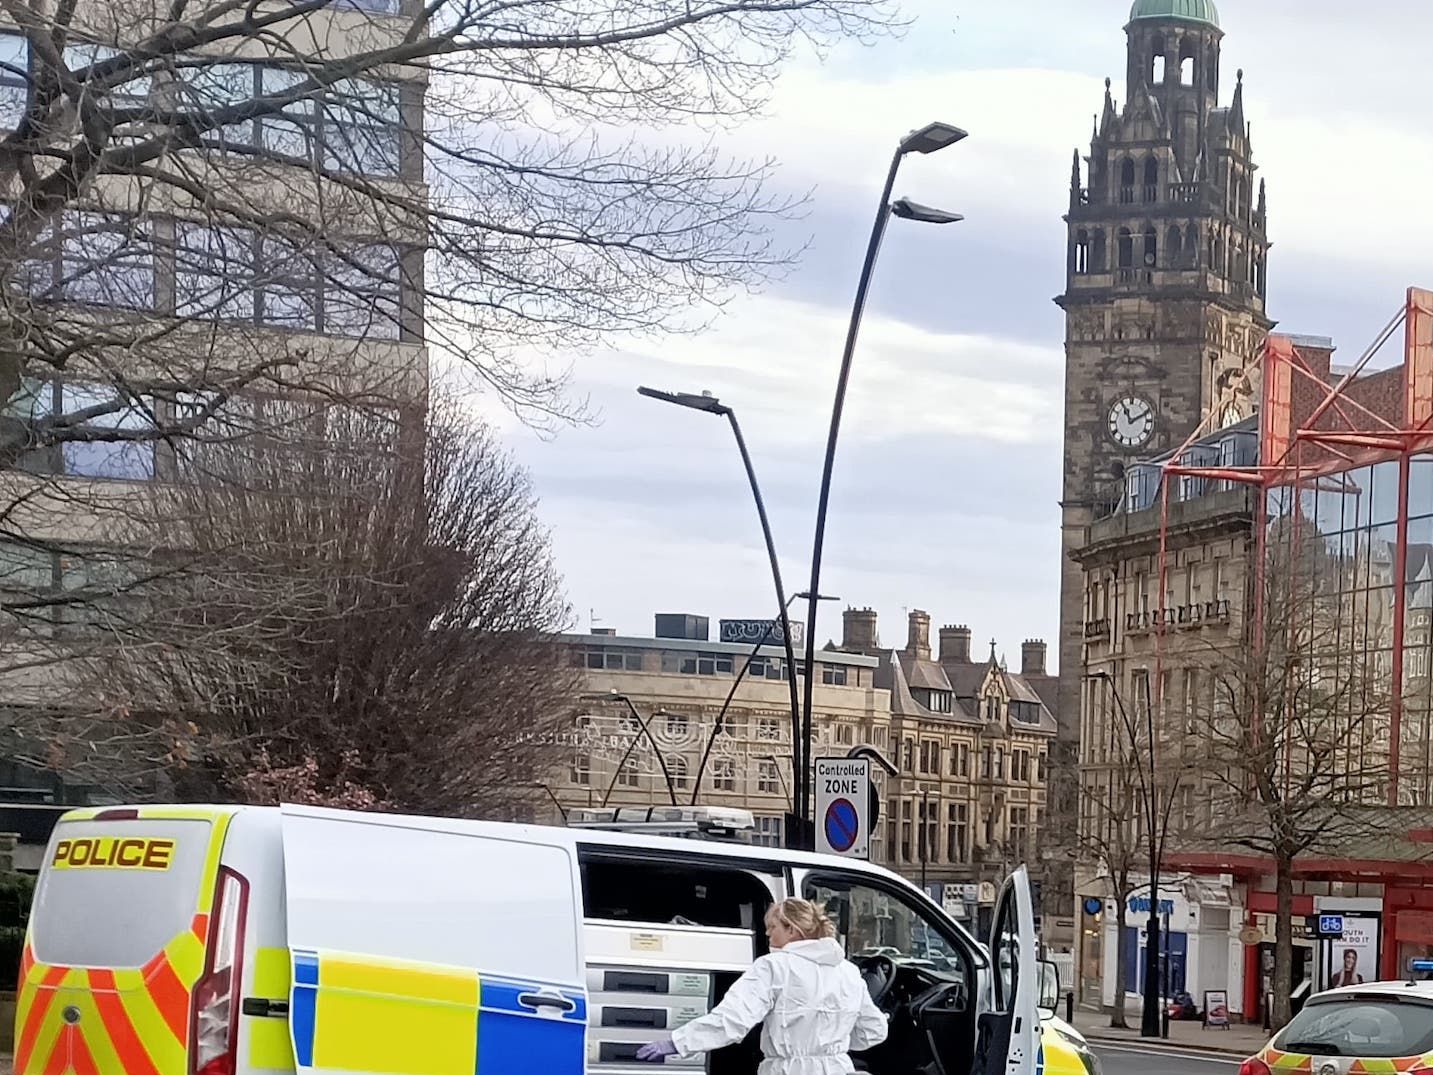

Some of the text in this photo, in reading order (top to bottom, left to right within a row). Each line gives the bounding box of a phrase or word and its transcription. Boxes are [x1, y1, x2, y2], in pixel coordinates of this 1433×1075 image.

[819, 764, 865, 776] Controlled
[825, 780, 858, 794] ZONE
[52, 839, 174, 868] POLICE
